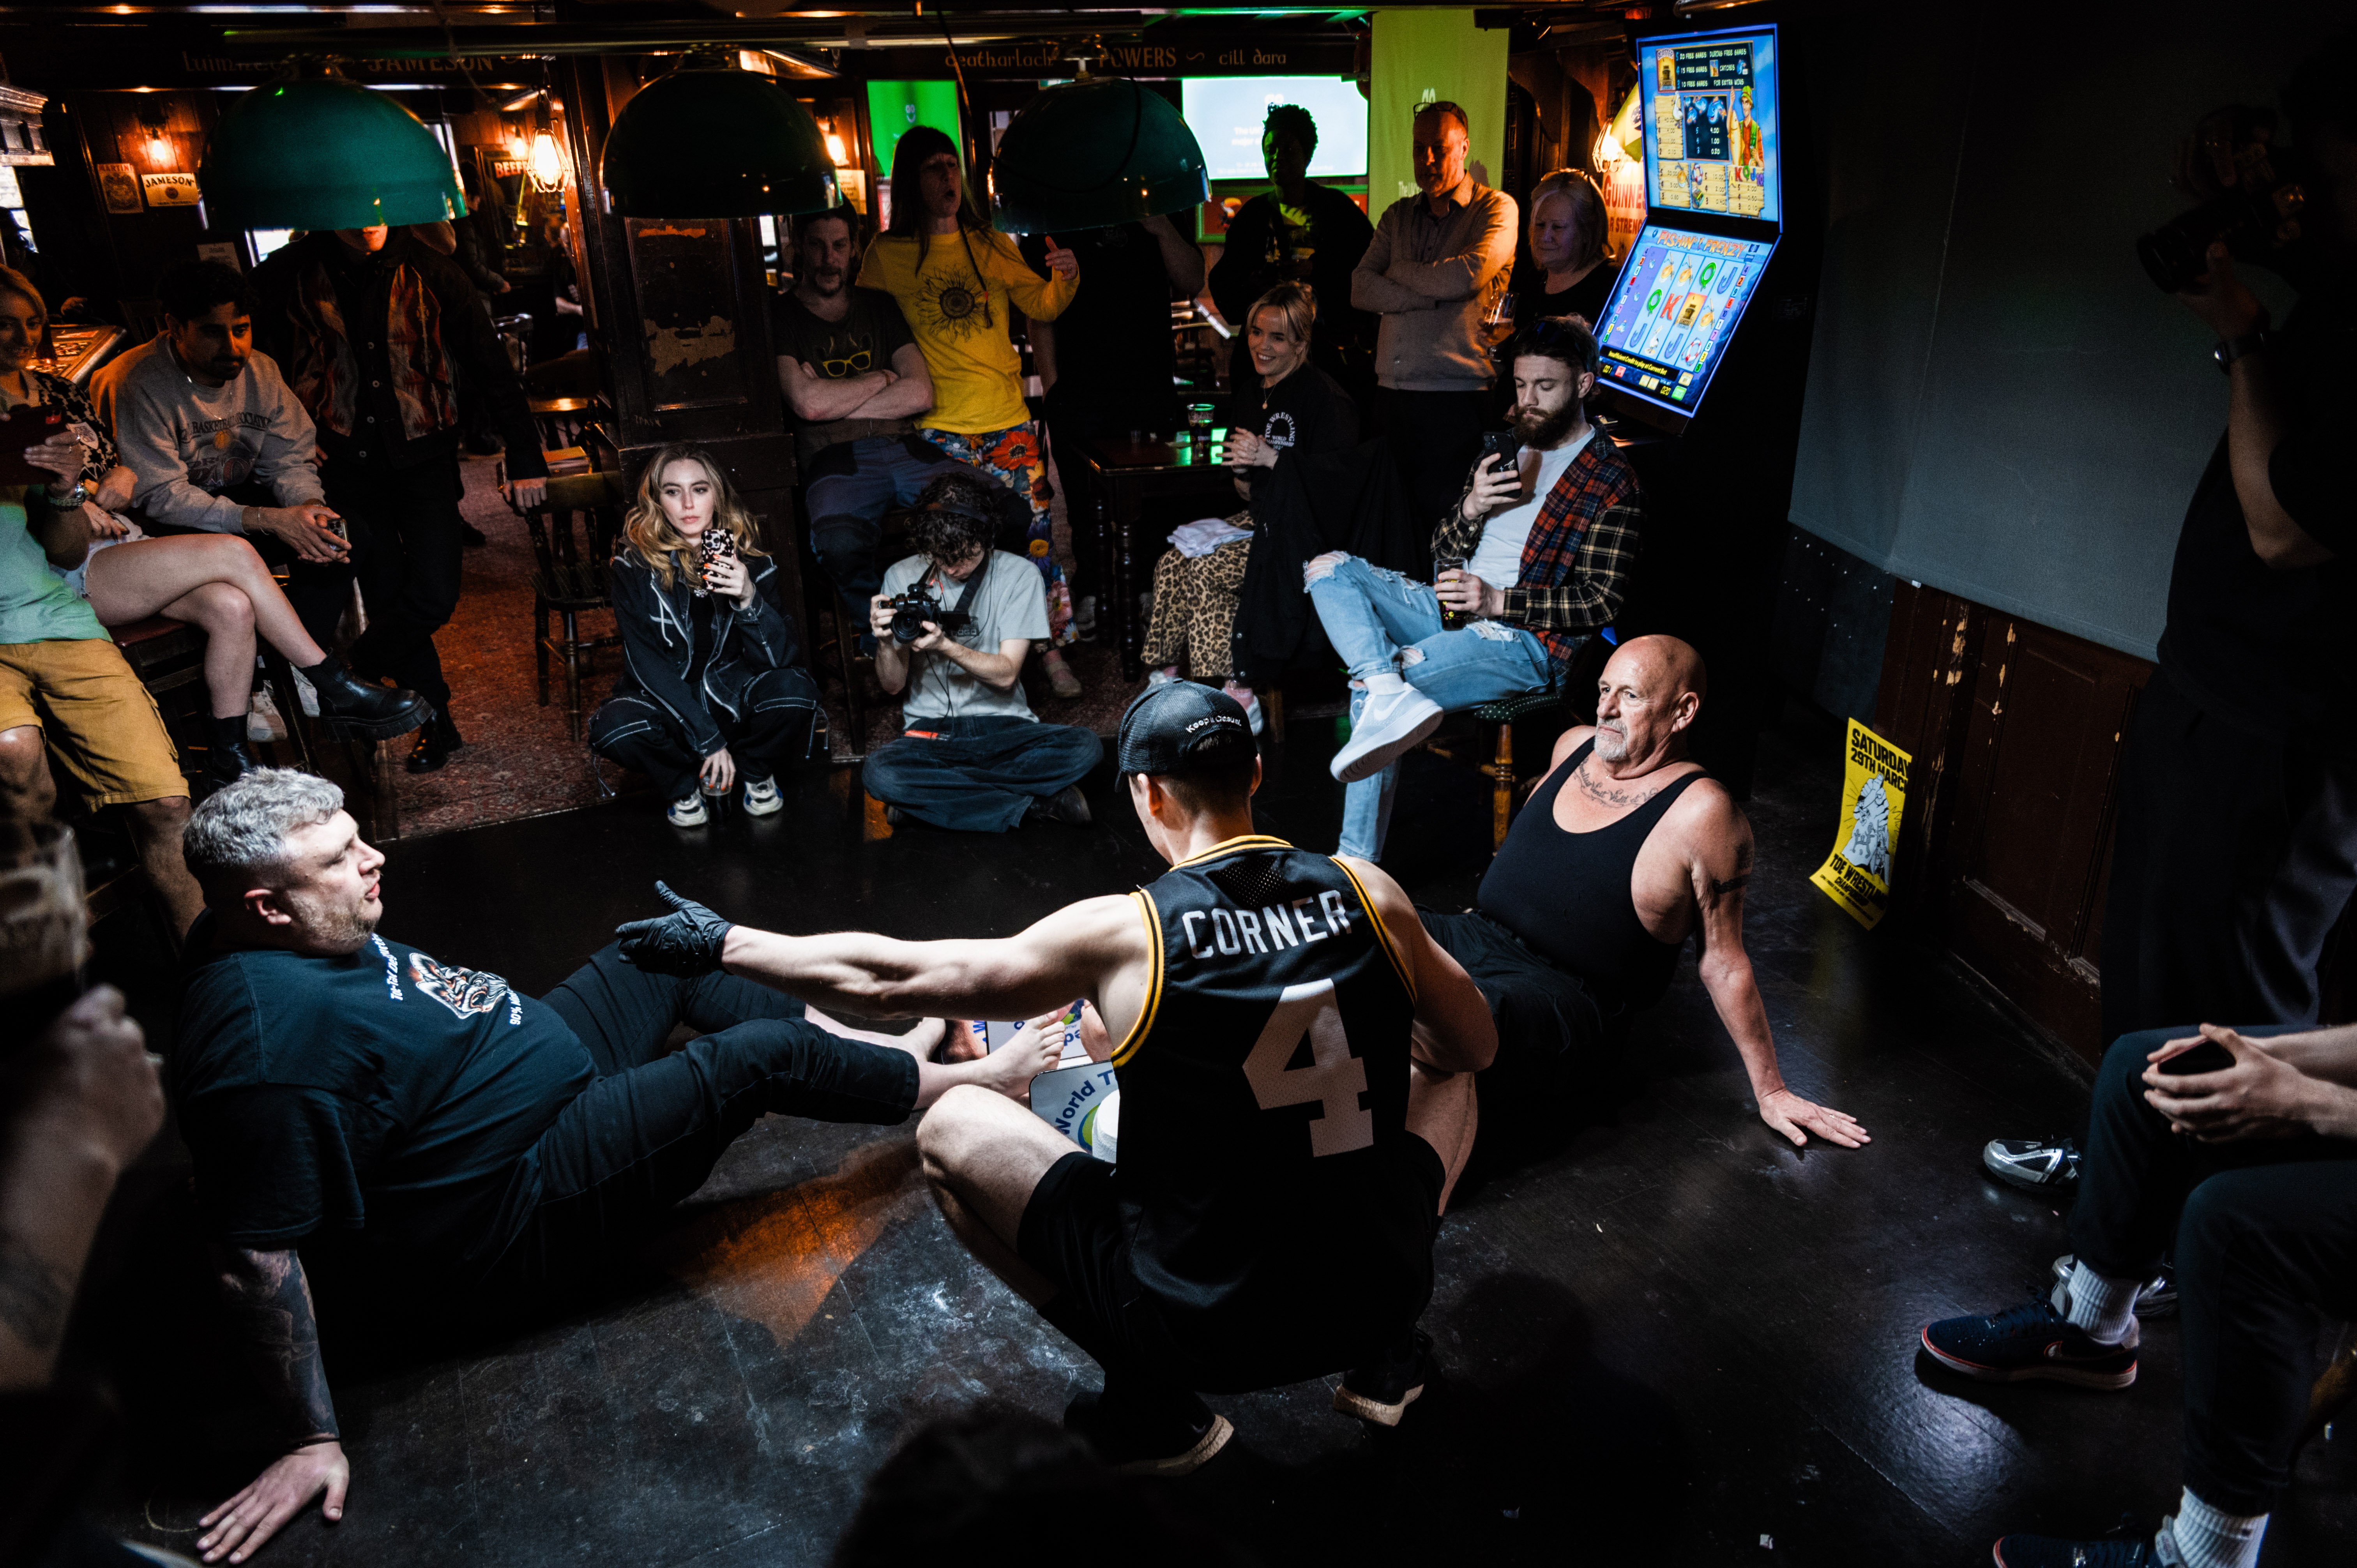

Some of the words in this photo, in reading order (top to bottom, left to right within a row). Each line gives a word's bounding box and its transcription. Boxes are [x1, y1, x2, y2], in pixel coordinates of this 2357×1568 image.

[1219, 48, 1246, 66] cill
[145, 176, 194, 187] JAMESON
[1735, 167, 1743, 182] K
[1743, 165, 1750, 182] Q
[1750, 168, 1756, 181] J
[1657, 230, 1697, 251] FISHIN'
[1703, 239, 1747, 258] FRENZY
[1660, 293, 1683, 320] K
[1608, 350, 1626, 361] Insufficient
[1626, 356, 1635, 365] Credit
[1648, 364, 1662, 374] Current
[1269, 411, 1295, 441] WRESTLING
[1267, 439, 1294, 447] HAMPIONSHIP
[1186, 718, 1209, 733] Keep
[1851, 747, 1876, 774] 29TH
[1852, 728, 1909, 779] SATURDAY
[1830, 853, 1847, 875] TOE
[1182, 888, 1353, 960] CORNER
[510, 1006, 523, 1025] 90%
[1242, 978, 1374, 1158] 4
[1055, 1080, 1096, 1135] World
